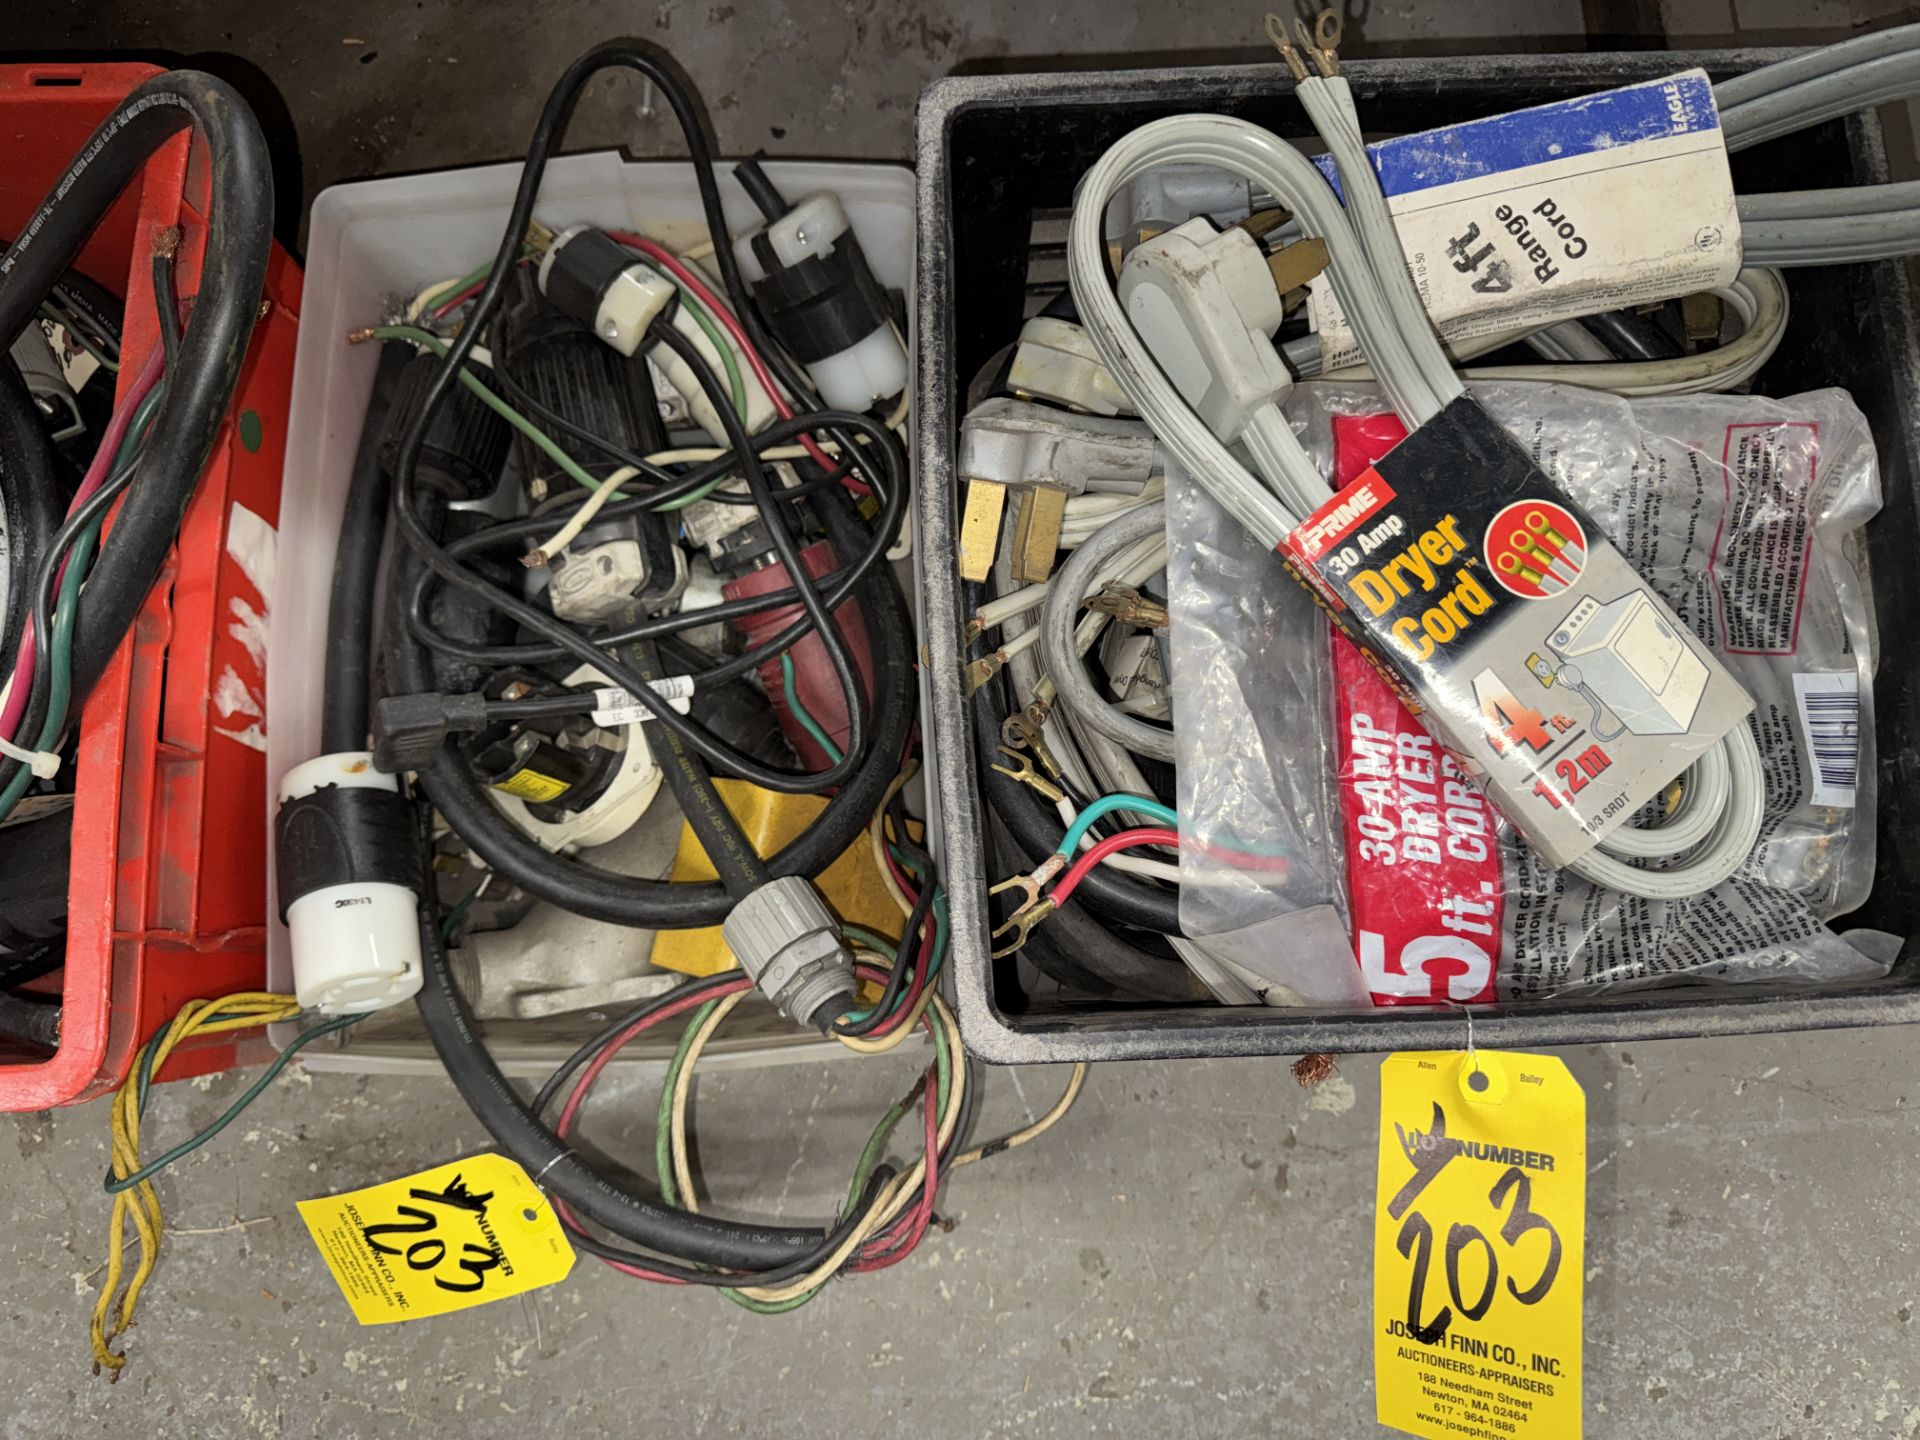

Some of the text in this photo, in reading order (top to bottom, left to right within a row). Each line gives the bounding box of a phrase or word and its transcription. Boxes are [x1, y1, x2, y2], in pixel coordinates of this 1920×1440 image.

[1664, 83, 1688, 133] EAGLE
[1495, 204, 1560, 285] Range
[1532, 198, 1587, 259] Cord
[1414, 251, 1425, 279] 10-50
[1445, 221, 1513, 294] 4ft
[1687, 450, 1705, 495] prevent
[1301, 485, 1379, 551] PRIME
[1691, 497, 1703, 510] to
[1744, 504, 1756, 528] NOT
[1328, 514, 1404, 577] 30 Amp
[1625, 513, 1637, 559] product
[1641, 532, 1649, 558] with
[1652, 525, 1659, 537] or
[1721, 573, 1738, 647] WARNING:
[1738, 436, 1750, 496] APPLIANCE
[1287, 552, 1336, 603] PRIME
[1347, 513, 1468, 619] Dryer
[1734, 548, 1751, 603] REWIRING,
[1756, 519, 1780, 649] MADE AND APPLIANCE IS
[1767, 488, 1796, 649] REASSEMBLED ACCORDING TO
[1391, 568, 1495, 662] Cord
[1746, 593, 1756, 614] ALL
[1780, 552, 1802, 649] MANUFACTURER'S
[1734, 605, 1745, 648] BEFORE
[1744, 617, 1755, 648] UNTIL
[1471, 667, 1577, 759] 4 ft.
[1769, 704, 1781, 729] amp
[1773, 731, 1784, 746] 30
[1782, 715, 1802, 787] device, such
[677, 755, 698, 783] WATER
[1351, 712, 1398, 866] 30-AMP
[1531, 743, 1613, 810] 1,2m
[1395, 731, 1442, 865] DRYER
[1580, 814, 1605, 837] 10/3
[1602, 791, 1632, 819] SRDT
[709, 812, 727, 834] DRY
[1518, 866, 1531, 910] CORD
[1629, 896, 1637, 919] Inse
[1734, 885, 1764, 916] power
[1359, 880, 1495, 1001] 5 ft.
[1513, 912, 1528, 960] DRYER
[1630, 921, 1642, 949] cord.
[1691, 908, 1714, 929] cord
[1710, 928, 1728, 945] not
[1716, 901, 1758, 951] of slack in
[1725, 927, 1747, 954] each
[1751, 917, 1781, 945] After
[1779, 929, 1791, 942] of
[1790, 926, 1801, 939] of
[1796, 915, 1812, 937] cap
[1725, 946, 1736, 957] is
[1417, 1060, 1438, 1071] Allen
[1456, 1138, 1556, 1173] NUMBER
[338, 1211, 396, 1308] AUCTIONEERS-APPRAISERS
[363, 1204, 500, 1293] 203
[1396, 1166, 1563, 1346] 203
[370, 1245, 387, 1268] INN
[393, 1290, 411, 1313] INC.
[1396, 1346, 1555, 1398] AUCTIONEERS-APPRAISERS
[1450, 1333, 1489, 1360] FINN
[1491, 1344, 1528, 1372] CO.,
[1531, 1353, 1567, 1379] INC.
[1417, 1371, 1534, 1411] 188 Needham Street
[1421, 1385, 1529, 1424] Newton, MA 02464
[1415, 1411, 1512, 1440] www.josephfinn
[1432, 1402, 1517, 1434] 617 964-1886
